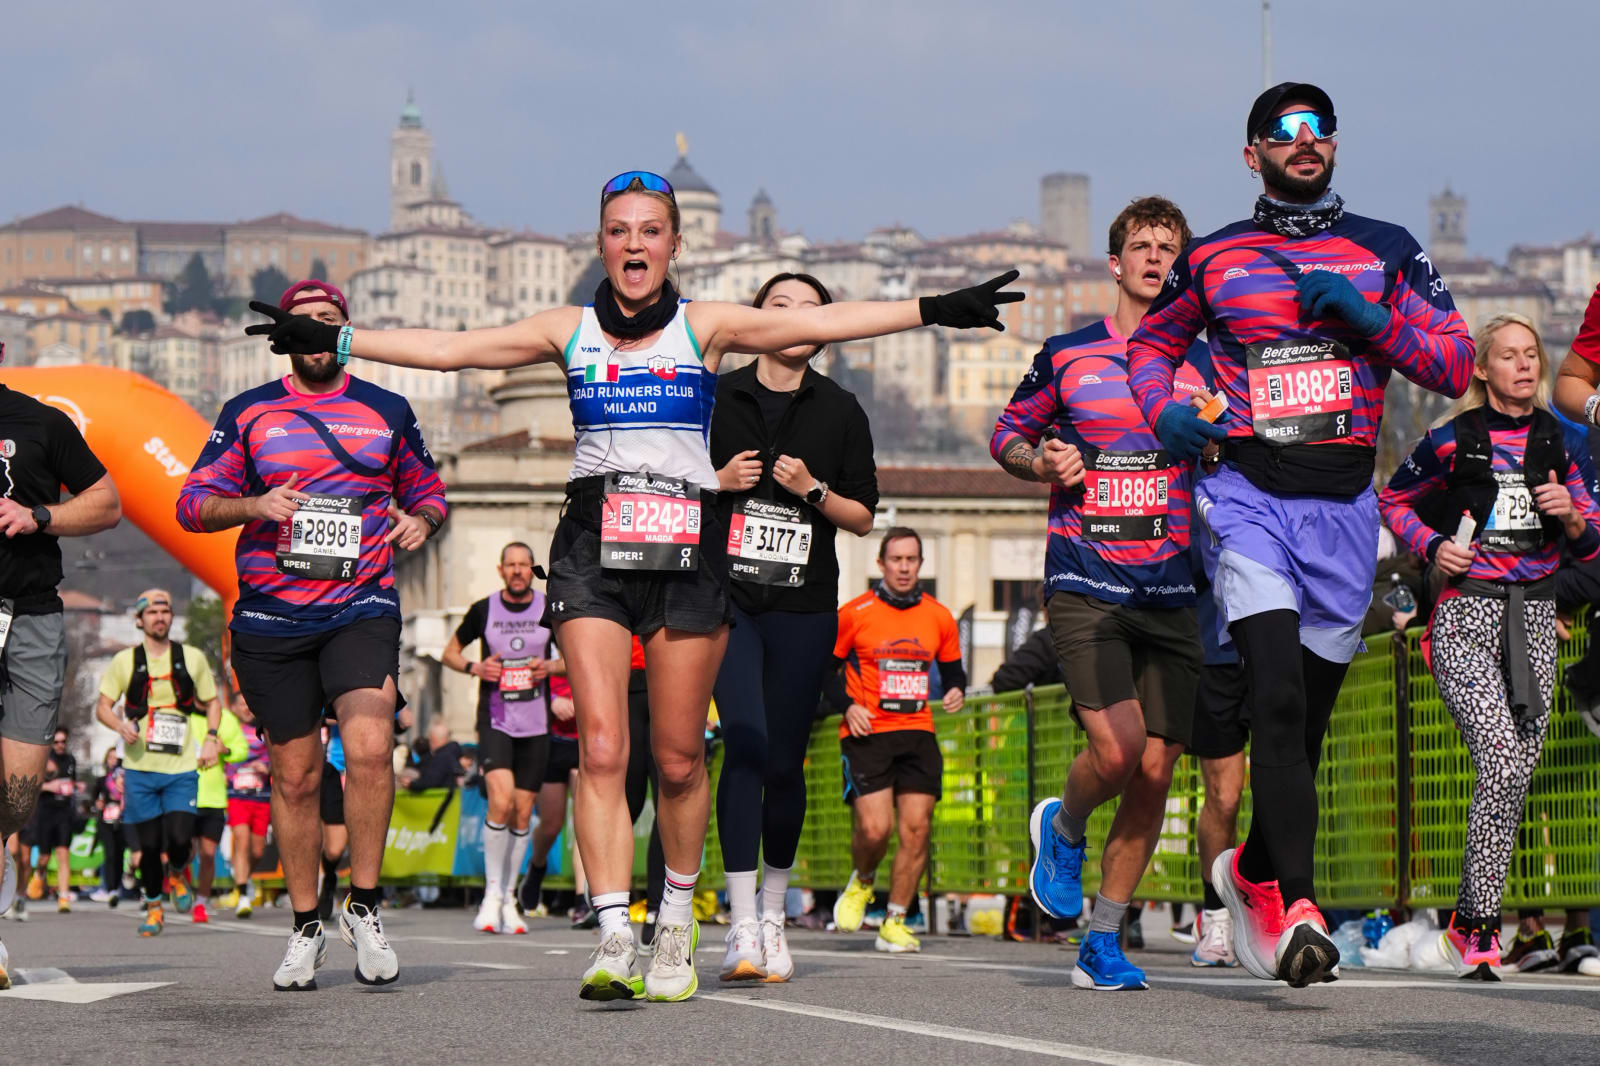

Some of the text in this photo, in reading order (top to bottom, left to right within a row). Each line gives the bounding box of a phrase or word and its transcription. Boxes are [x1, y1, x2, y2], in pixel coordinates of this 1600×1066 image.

[1261, 342, 1335, 359] Bergamo21
[653, 360, 674, 374] PL
[597, 385, 662, 398] RUNNERS
[665, 385, 694, 398] CLUB
[1284, 368, 1337, 406] 1882
[1255, 387, 1266, 401] 3
[604, 401, 657, 414] MILANO
[1304, 405, 1322, 414] PLM
[339, 424, 394, 439] Bergamo21
[1265, 426, 1299, 438] BPER:
[143, 436, 188, 477] Stay
[1095, 453, 1158, 466] Bergamo21
[1086, 487, 1096, 499] 3
[1111, 477, 1156, 507] 1886
[744, 499, 801, 517] Bergamo21
[607, 511, 617, 524] 3
[635, 501, 685, 533] 2242
[281, 525, 290, 537] 3
[304, 518, 348, 548] 2898
[731, 529, 741, 540] 3
[1090, 524, 1120, 533] BPER:
[645, 534, 674, 542] MAGDA
[756, 525, 796, 554] 3177
[313, 548, 337, 556] DANIEL
[611, 551, 644, 561] BPER:
[283, 559, 311, 570] BPER:
[732, 563, 759, 575] BPER:
[1056, 571, 1134, 595] FollowYourPassion
[895, 674, 919, 694] 1206
